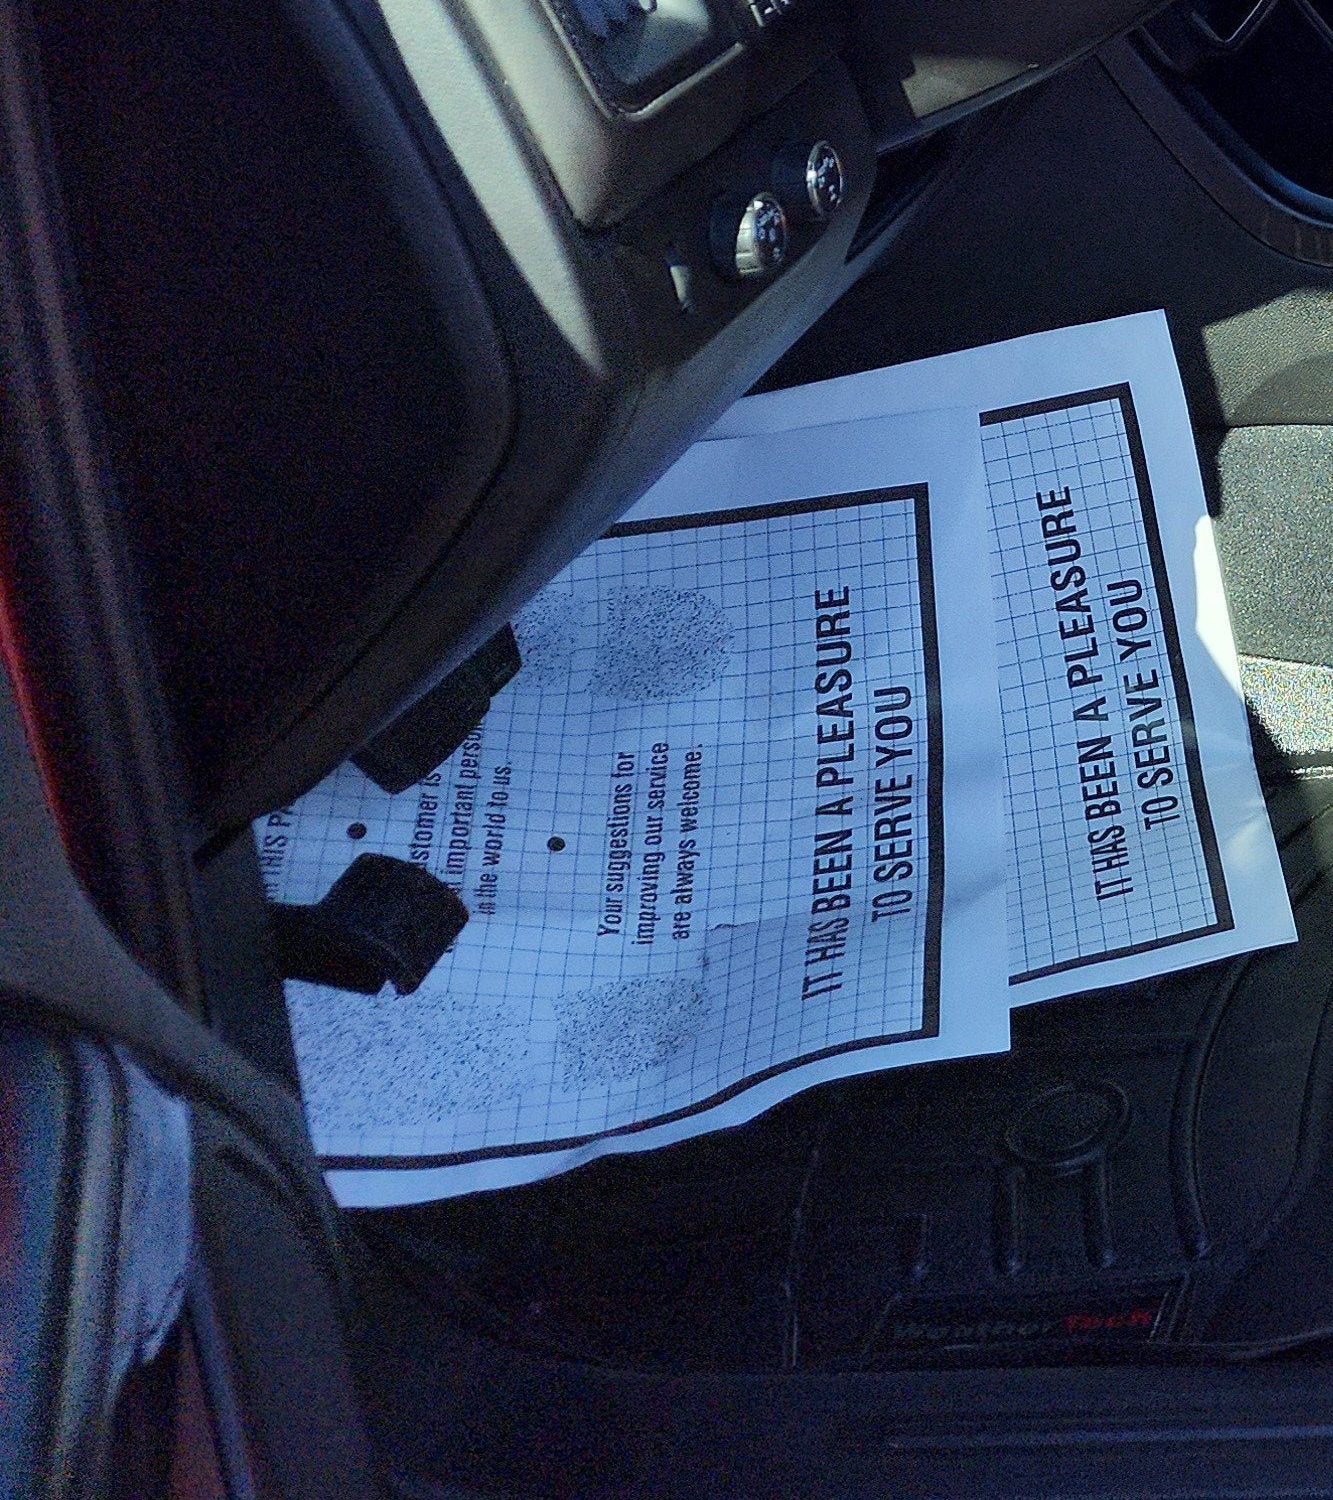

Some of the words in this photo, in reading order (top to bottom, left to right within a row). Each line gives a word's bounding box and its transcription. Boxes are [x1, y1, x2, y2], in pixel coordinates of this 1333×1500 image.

[1036, 485, 1104, 689] PLEASURE
[1106, 579, 1152, 662] YOU
[814, 585, 855, 788] PLEASURE
[1072, 696, 1109, 722] A
[873, 685, 914, 768] YOU
[1123, 668, 1174, 789] SERVE
[493, 761, 513, 787] us.
[611, 751, 635, 779] for
[645, 742, 670, 811] service
[677, 743, 703, 834] welcome.
[1076, 735, 1122, 821] BEEN
[487, 789, 509, 808] to
[815, 796, 854, 816] A
[1140, 795, 1180, 831] TO
[440, 783, 476, 875] important
[482, 812, 506, 867] world
[606, 783, 632, 893] suggestions
[644, 816, 663, 846] our
[873, 774, 914, 884] SERVE
[1087, 824, 1130, 874] HAS
[474, 872, 498, 899] the
[631, 851, 666, 945] improving
[670, 838, 700, 905] always
[811, 828, 853, 915] BEEN
[1094, 876, 1134, 901] IT
[597, 898, 624, 936] Your
[672, 911, 692, 940] are
[871, 889, 913, 923] TO
[804, 916, 850, 967] HAS
[801, 970, 843, 1001] IT
